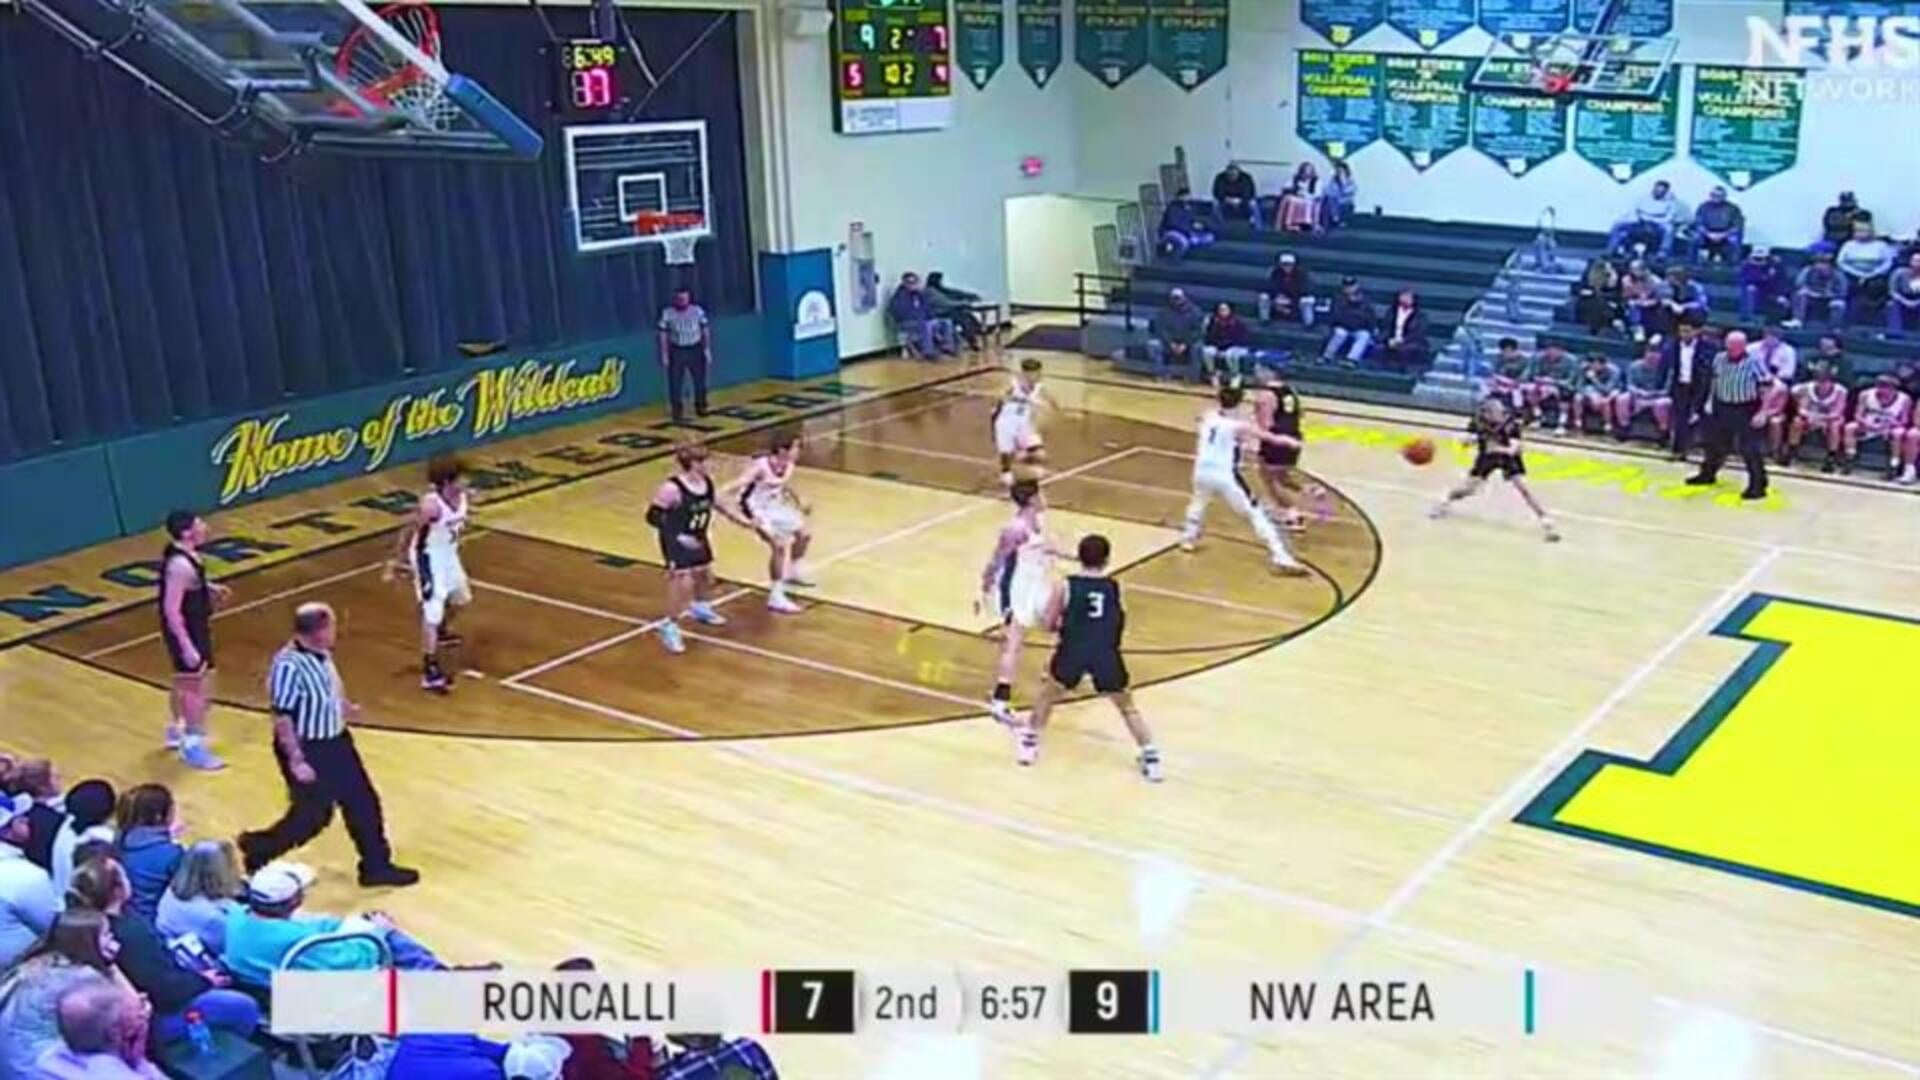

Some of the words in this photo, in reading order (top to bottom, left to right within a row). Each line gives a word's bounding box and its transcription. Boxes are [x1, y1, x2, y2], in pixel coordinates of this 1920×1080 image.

[860, 24, 875, 51] 9
[890, 27, 903, 50] 2
[212, 412, 358, 505] Home
[361, 393, 411, 472] of
[406, 386, 466, 440] the
[456, 357, 627, 439] Wildcats
[1087, 592, 1105, 618] 3
